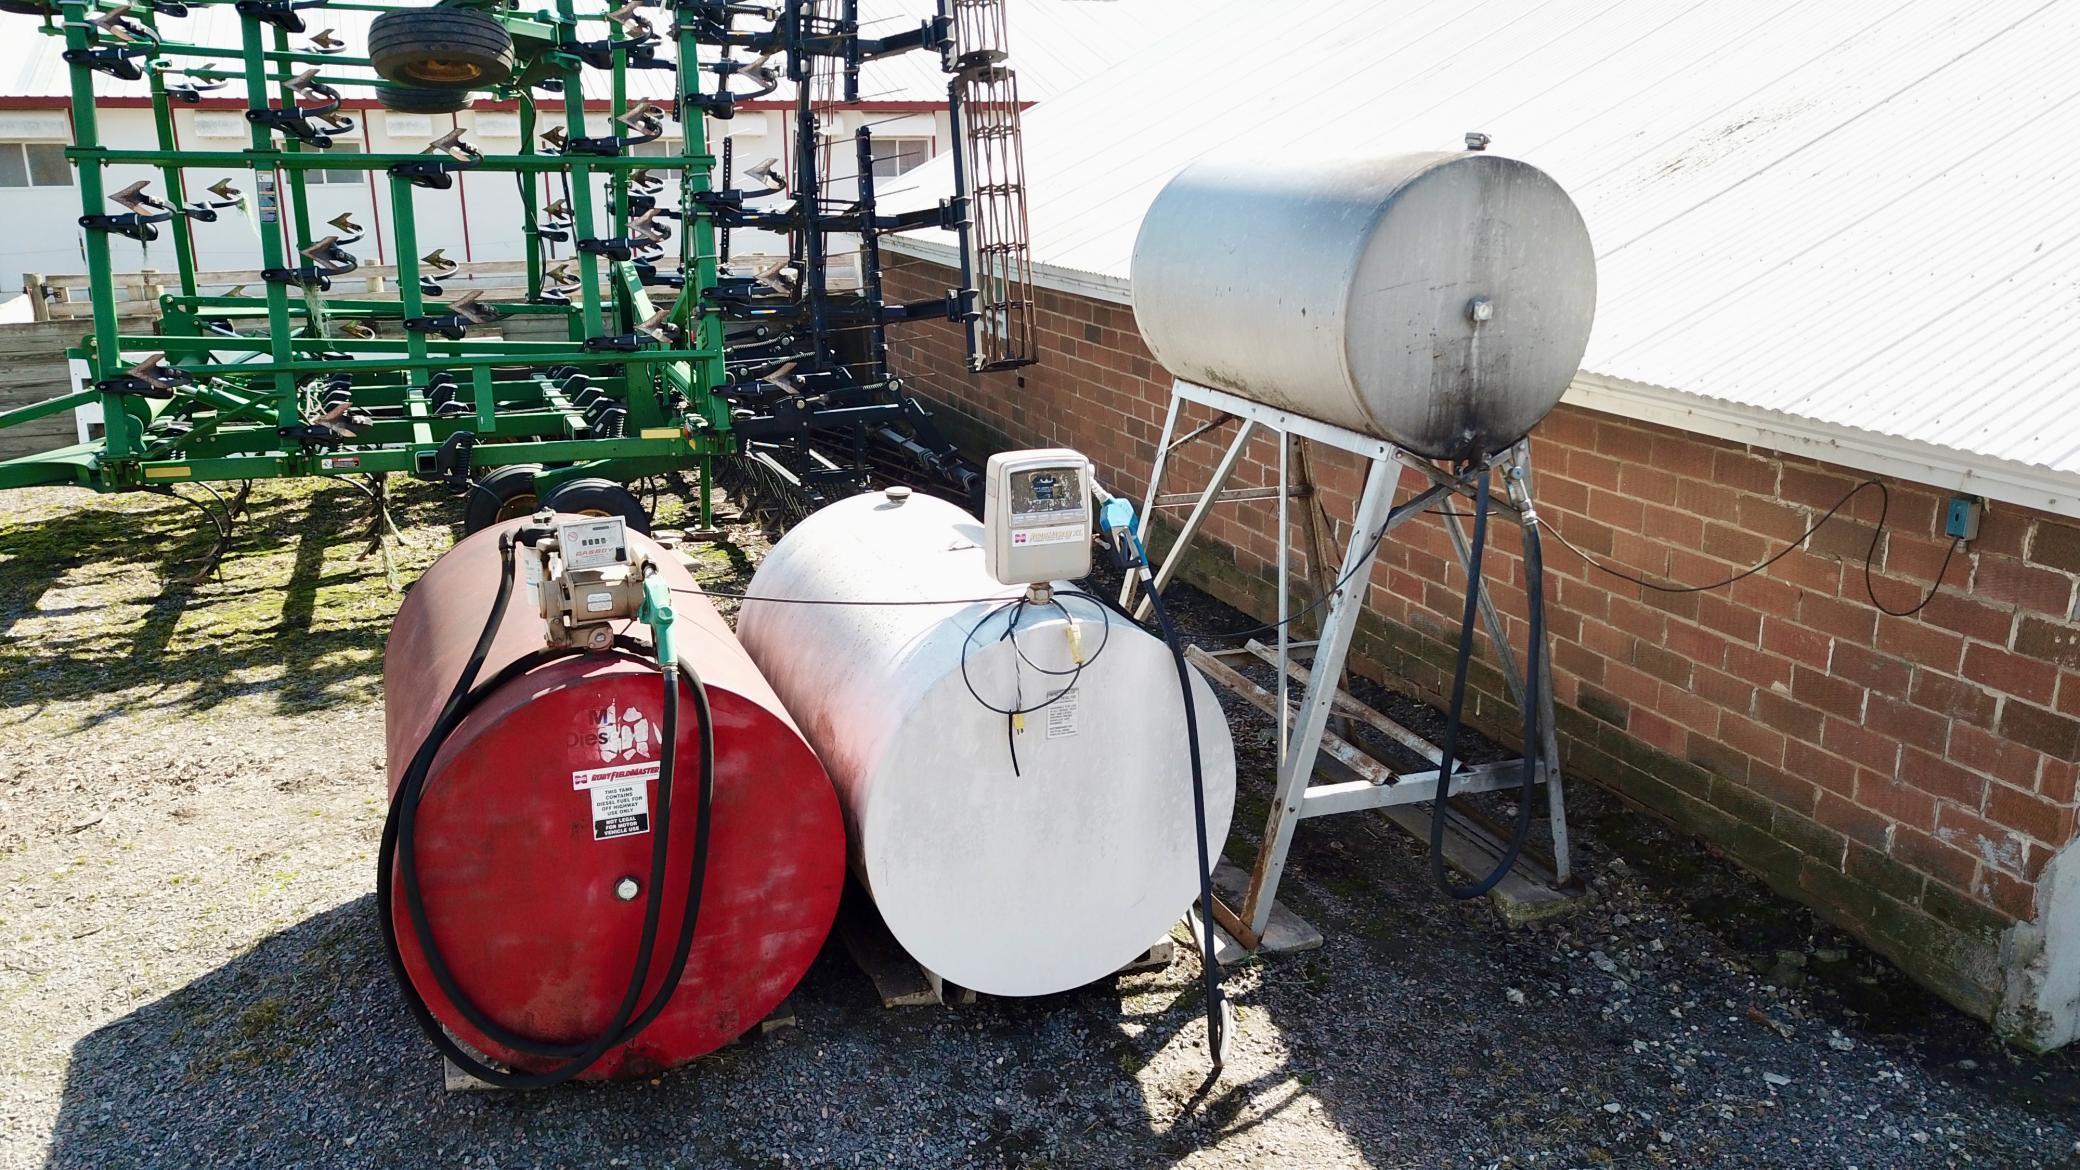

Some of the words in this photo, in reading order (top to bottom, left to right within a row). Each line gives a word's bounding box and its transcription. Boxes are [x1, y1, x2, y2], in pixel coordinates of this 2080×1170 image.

[576, 547, 614, 557] GASBOY
[605, 792, 633, 800] CONTAINS
[613, 802, 638, 810] HIGHWAY
